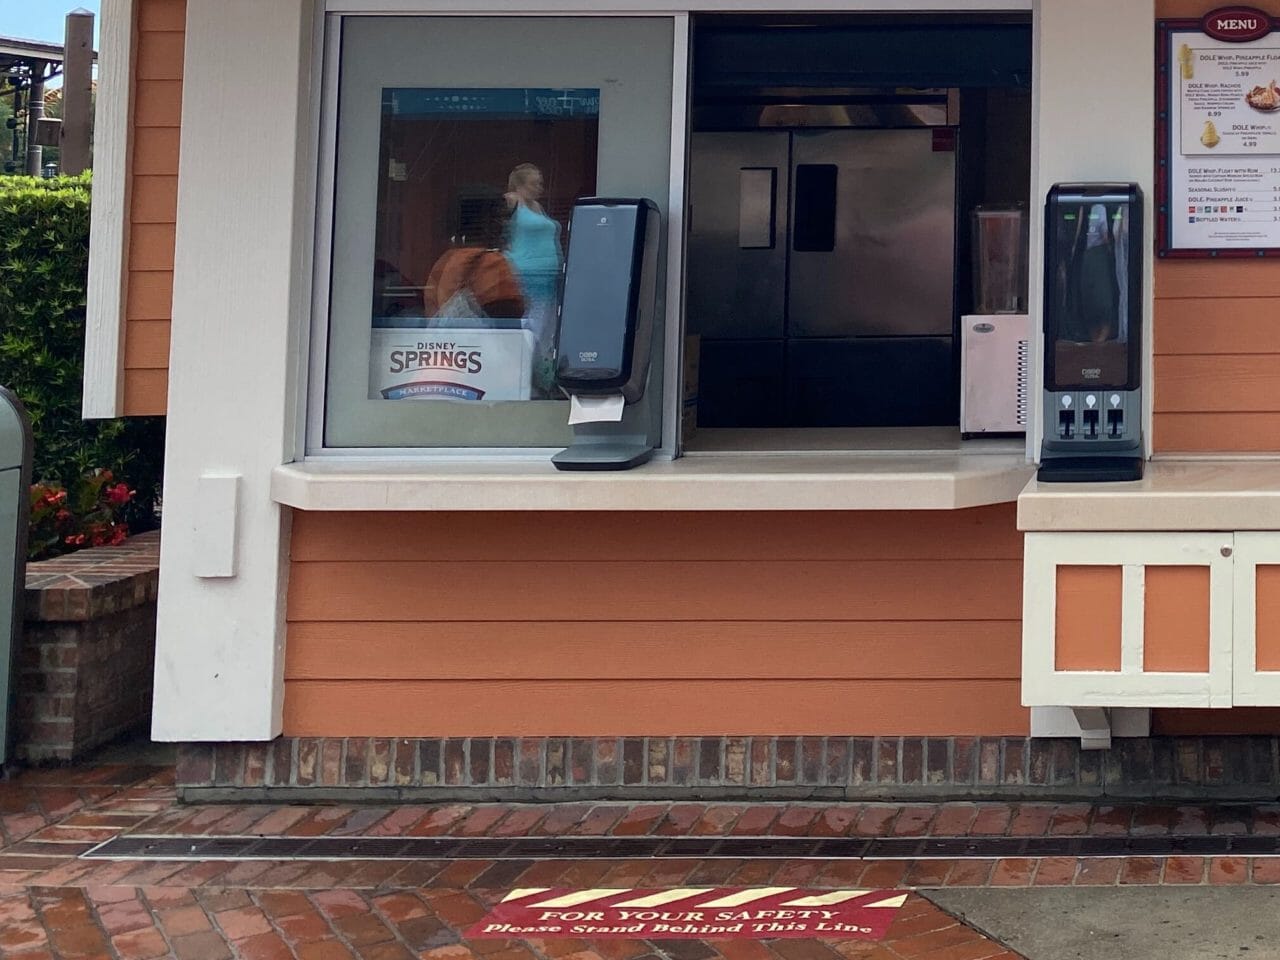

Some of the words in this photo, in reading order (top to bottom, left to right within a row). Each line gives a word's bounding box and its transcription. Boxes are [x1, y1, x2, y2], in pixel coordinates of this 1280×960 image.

[1216, 19, 1257, 30] MENU
[417, 342, 456, 350] DISNEY
[390, 351, 481, 373] SPRINGS
[538, 911, 604, 921] FOR
[619, 911, 704, 921] YOUR
[715, 910, 841, 920] SAFETY
[482, 923, 562, 933] Please
[570, 923, 645, 933] Stand
[651, 923, 744, 933] Behind
[751, 922, 808, 932] This
[814, 922, 873, 934] Line
